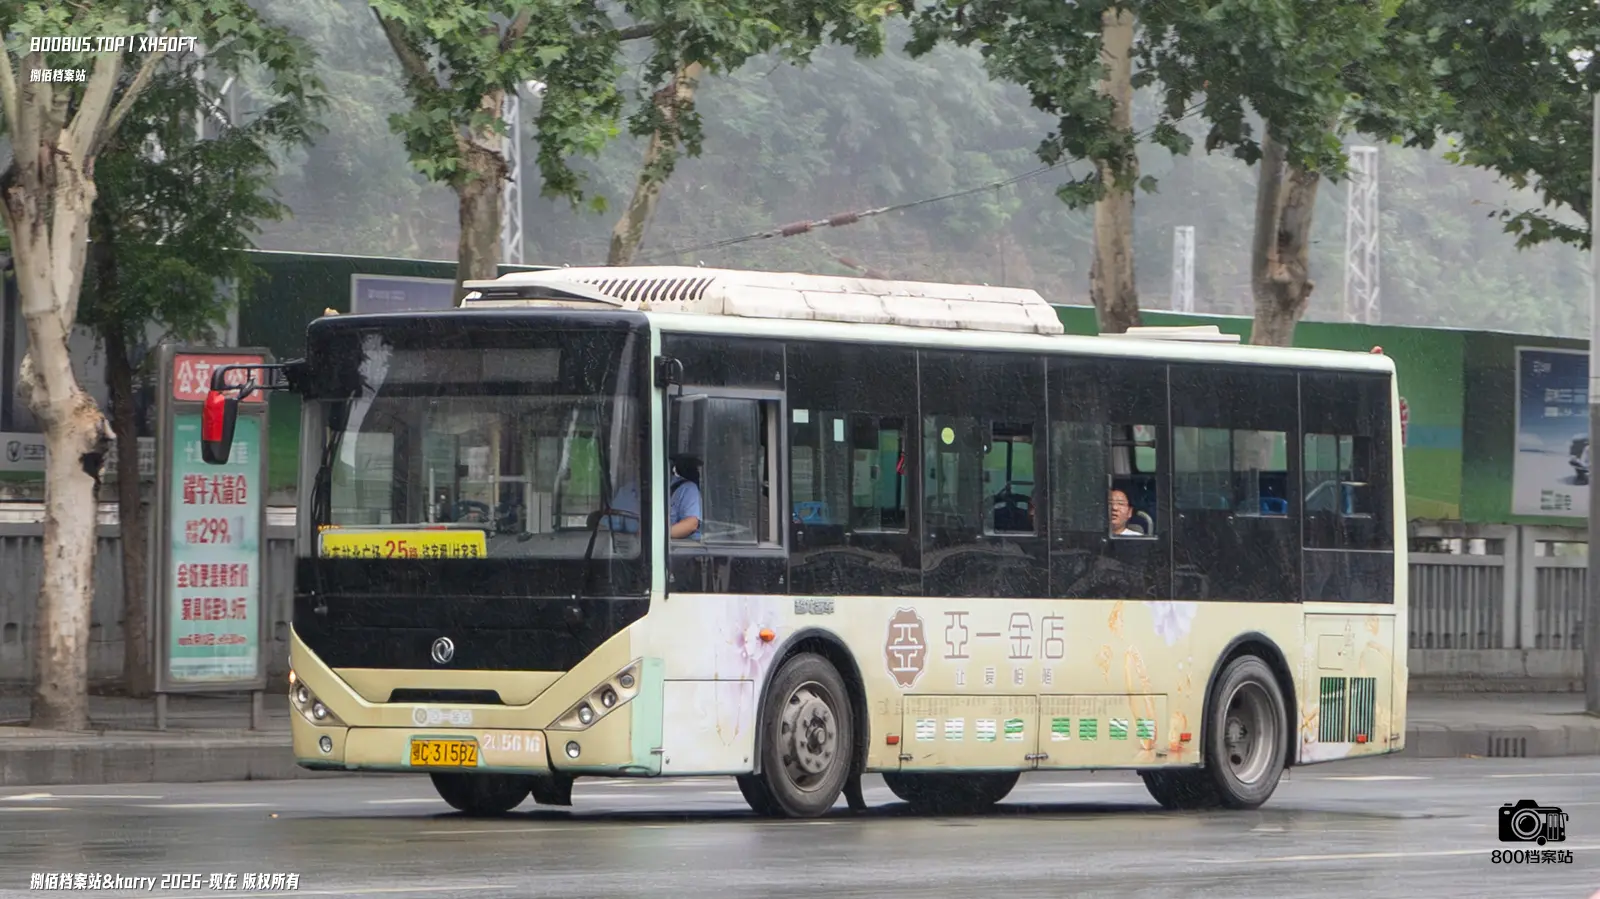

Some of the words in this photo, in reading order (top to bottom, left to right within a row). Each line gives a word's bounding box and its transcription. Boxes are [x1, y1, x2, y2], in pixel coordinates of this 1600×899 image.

[183, 474, 247, 504] 端午大清仓
